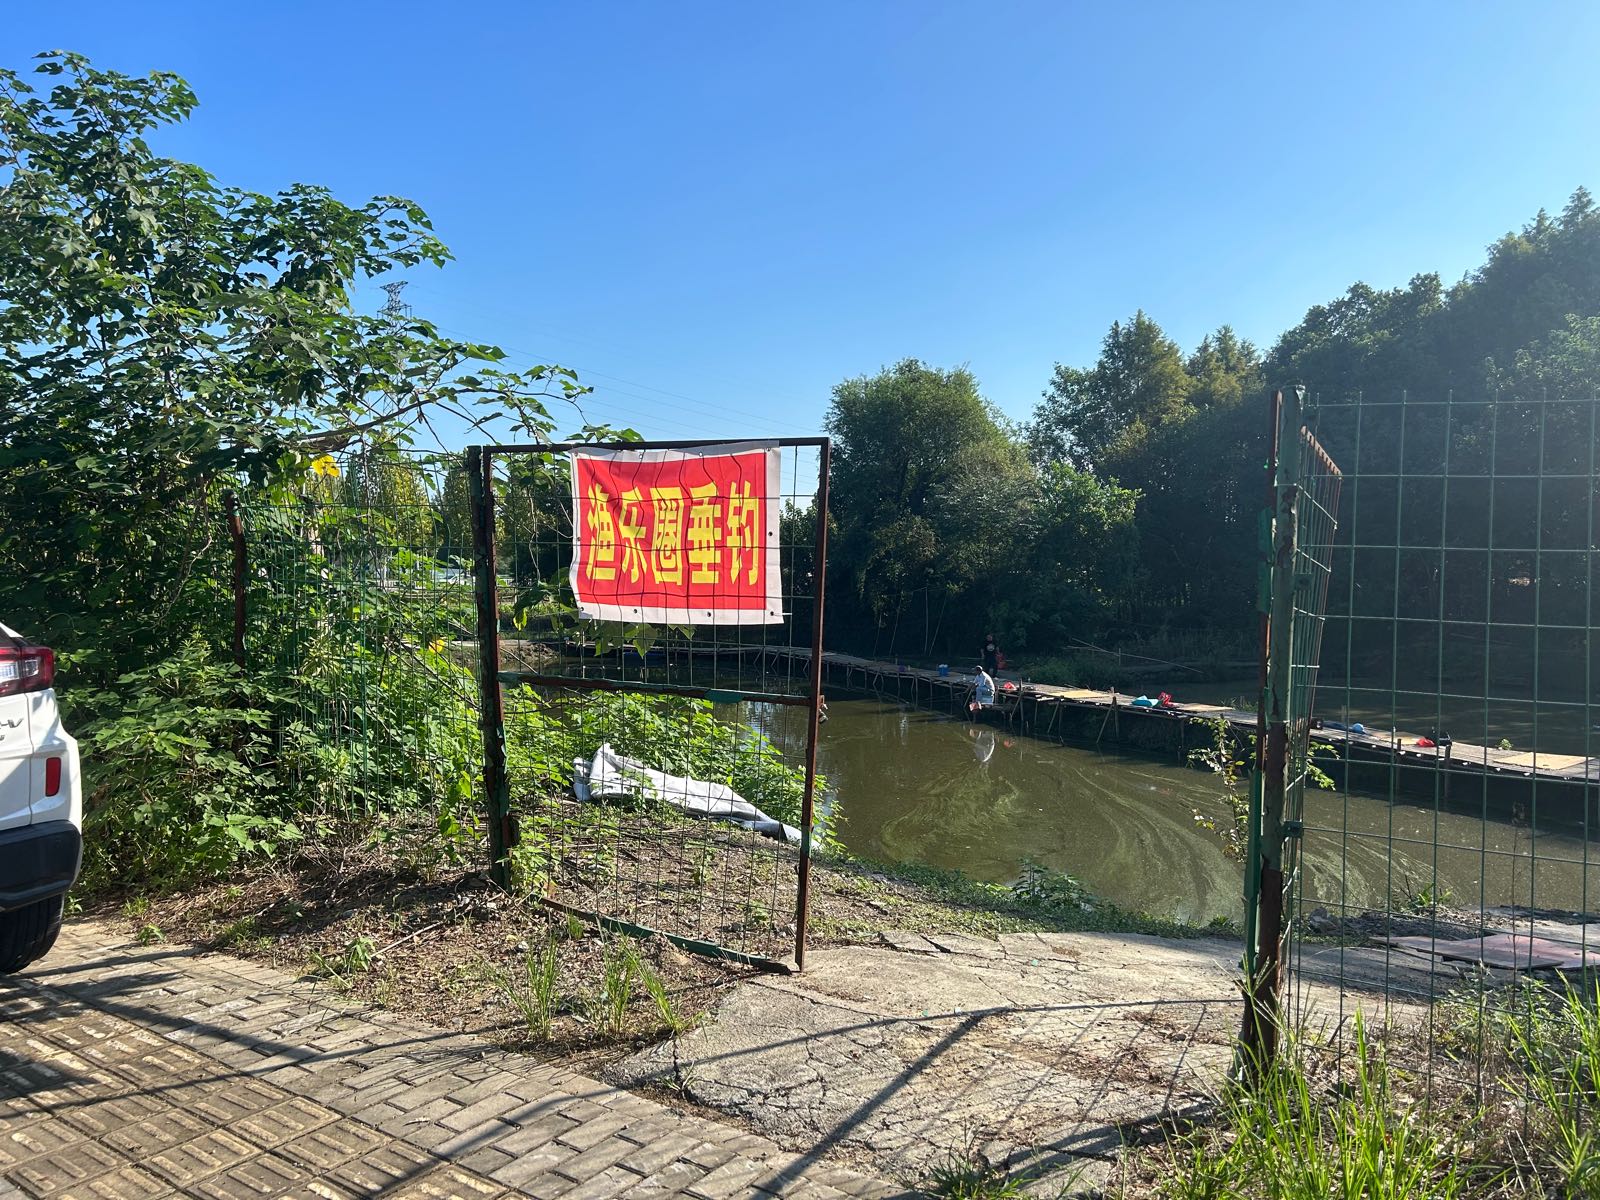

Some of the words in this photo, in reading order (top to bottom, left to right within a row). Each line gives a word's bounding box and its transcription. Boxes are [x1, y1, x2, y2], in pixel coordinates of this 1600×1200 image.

[586, 480, 760, 586] 渔乐圈垂钓
